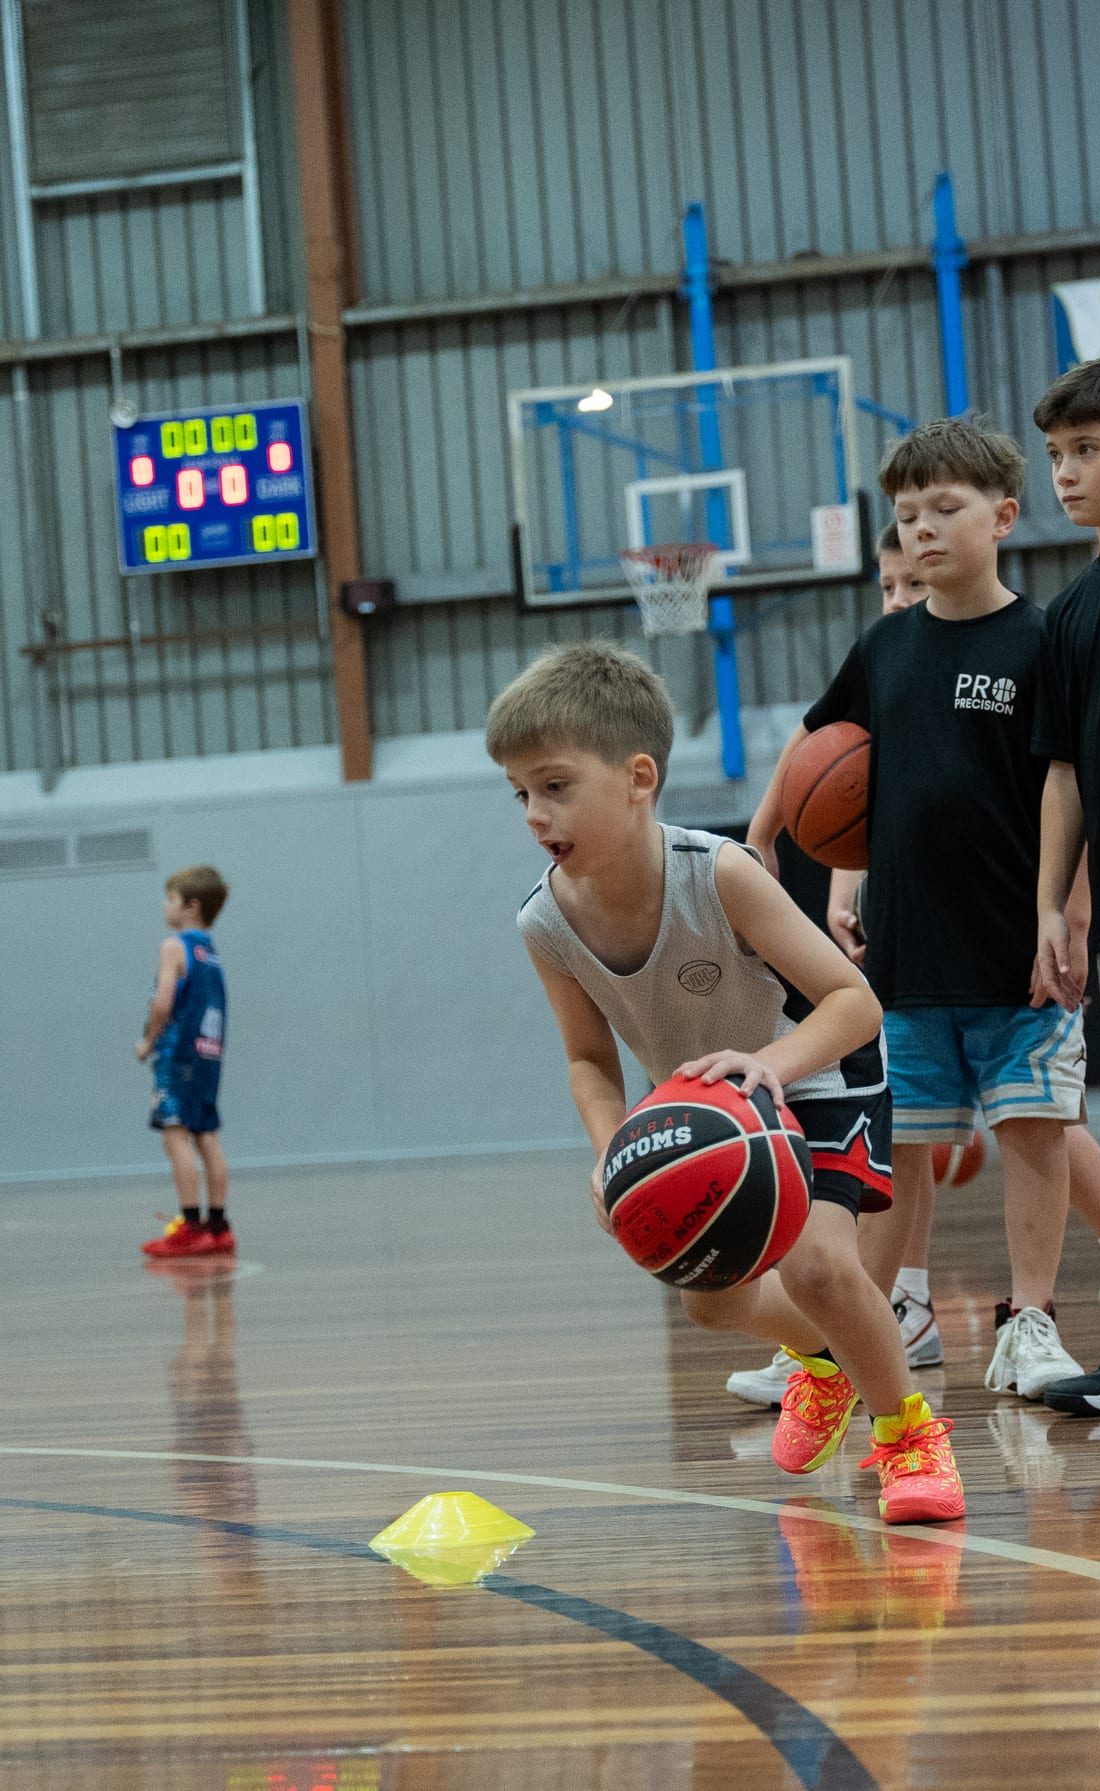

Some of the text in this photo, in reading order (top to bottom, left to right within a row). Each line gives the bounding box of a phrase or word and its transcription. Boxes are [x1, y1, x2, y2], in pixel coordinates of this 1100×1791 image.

[954, 697, 1015, 716] PRECISION
[604, 1126, 692, 1191] ANTOMS
[673, 1181, 725, 1242] JAXON
